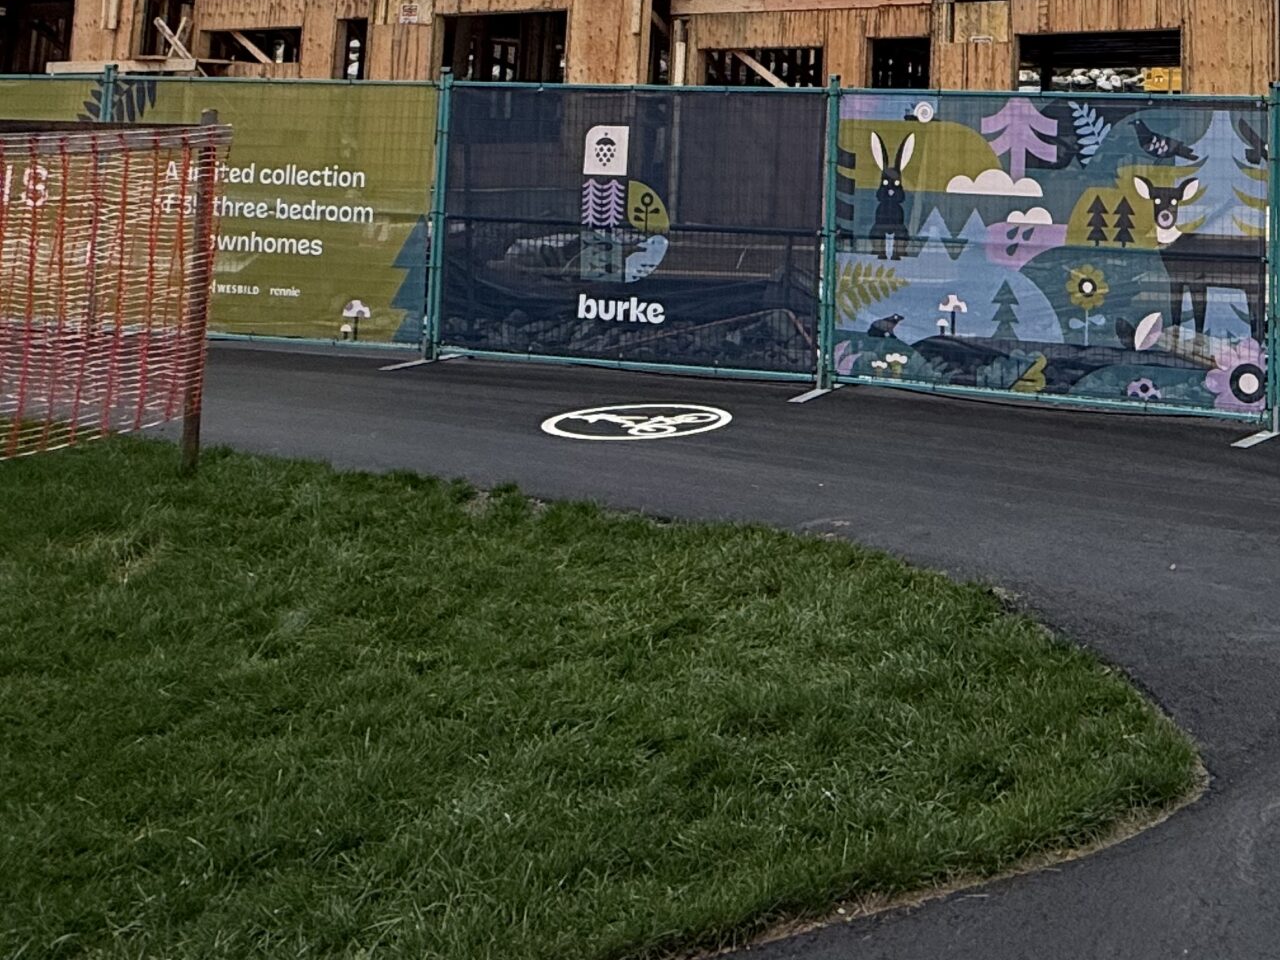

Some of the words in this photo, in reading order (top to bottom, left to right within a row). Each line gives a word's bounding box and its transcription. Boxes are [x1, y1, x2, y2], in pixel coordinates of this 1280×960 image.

[259, 164, 366, 187] collection
[212, 195, 374, 224] three-bedroom
[216, 283, 260, 296] WESBILD
[577, 293, 666, 325] burke
